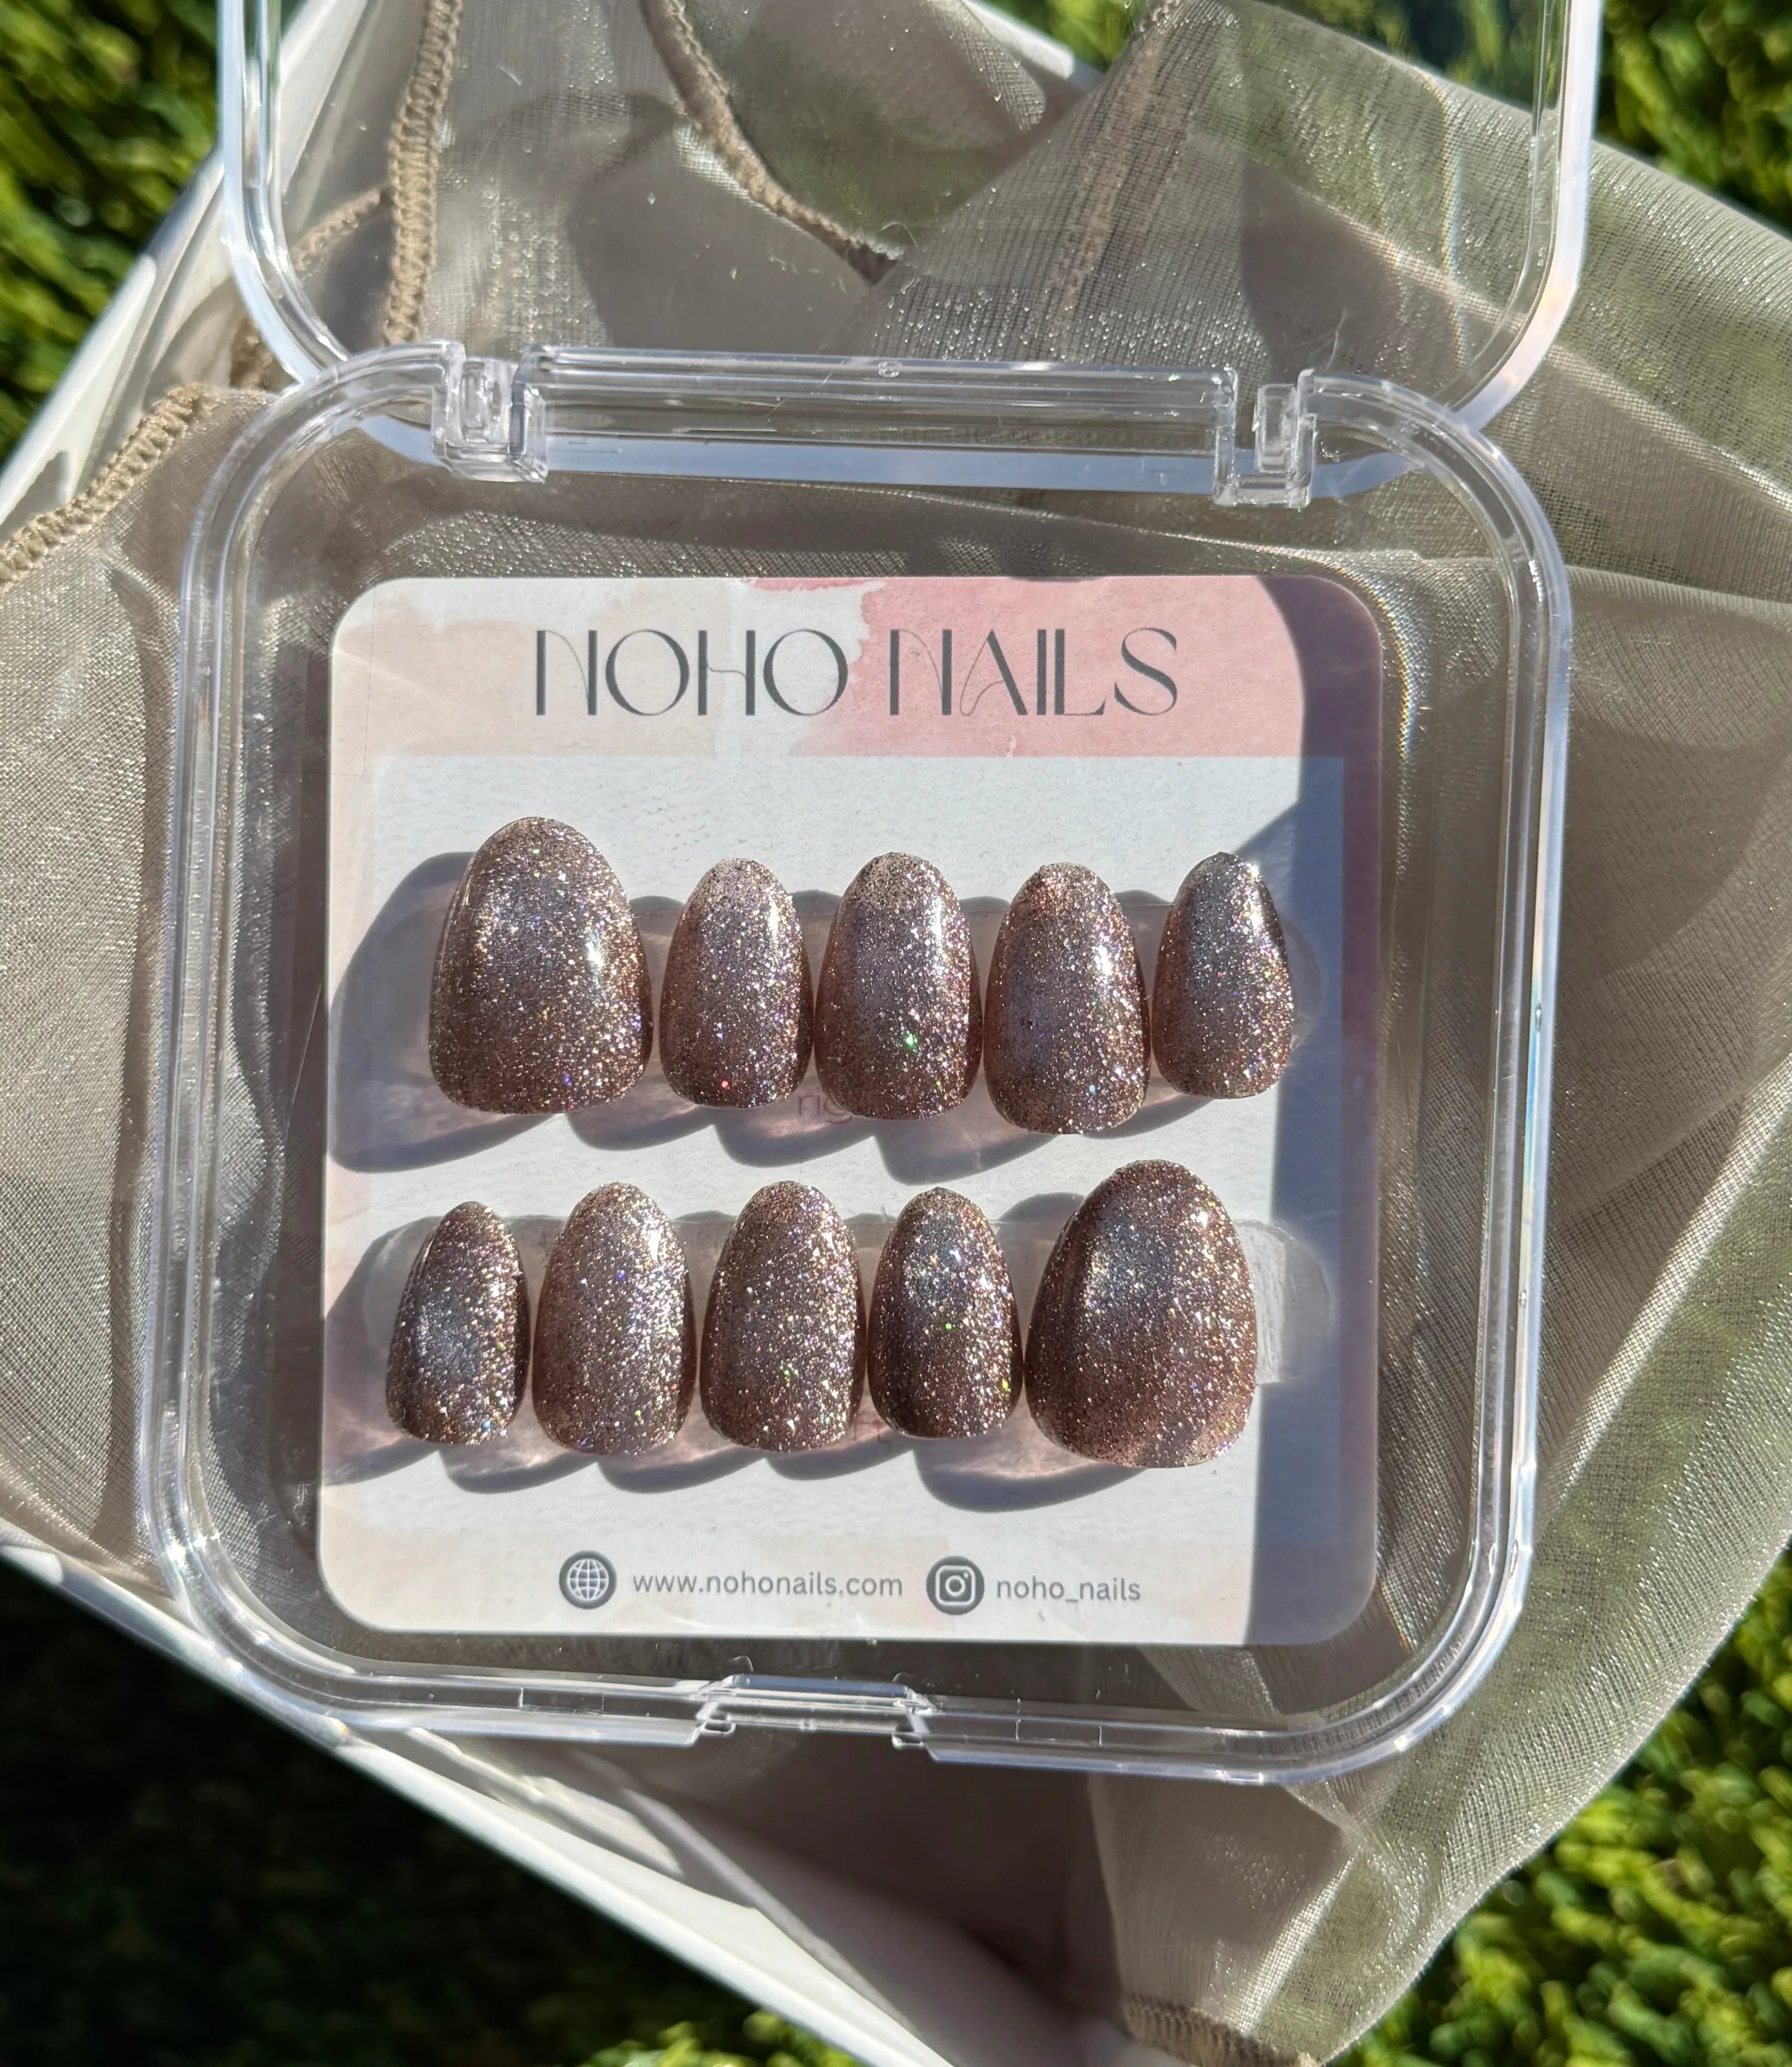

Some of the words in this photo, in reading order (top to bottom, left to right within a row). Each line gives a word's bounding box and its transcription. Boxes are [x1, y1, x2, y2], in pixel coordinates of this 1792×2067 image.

[536, 628, 849, 716] NOHO
[889, 627, 1178, 716] NAILS
[632, 1570, 903, 1597] www.nohonails.com
[996, 1575, 1141, 1604] noho_nails
